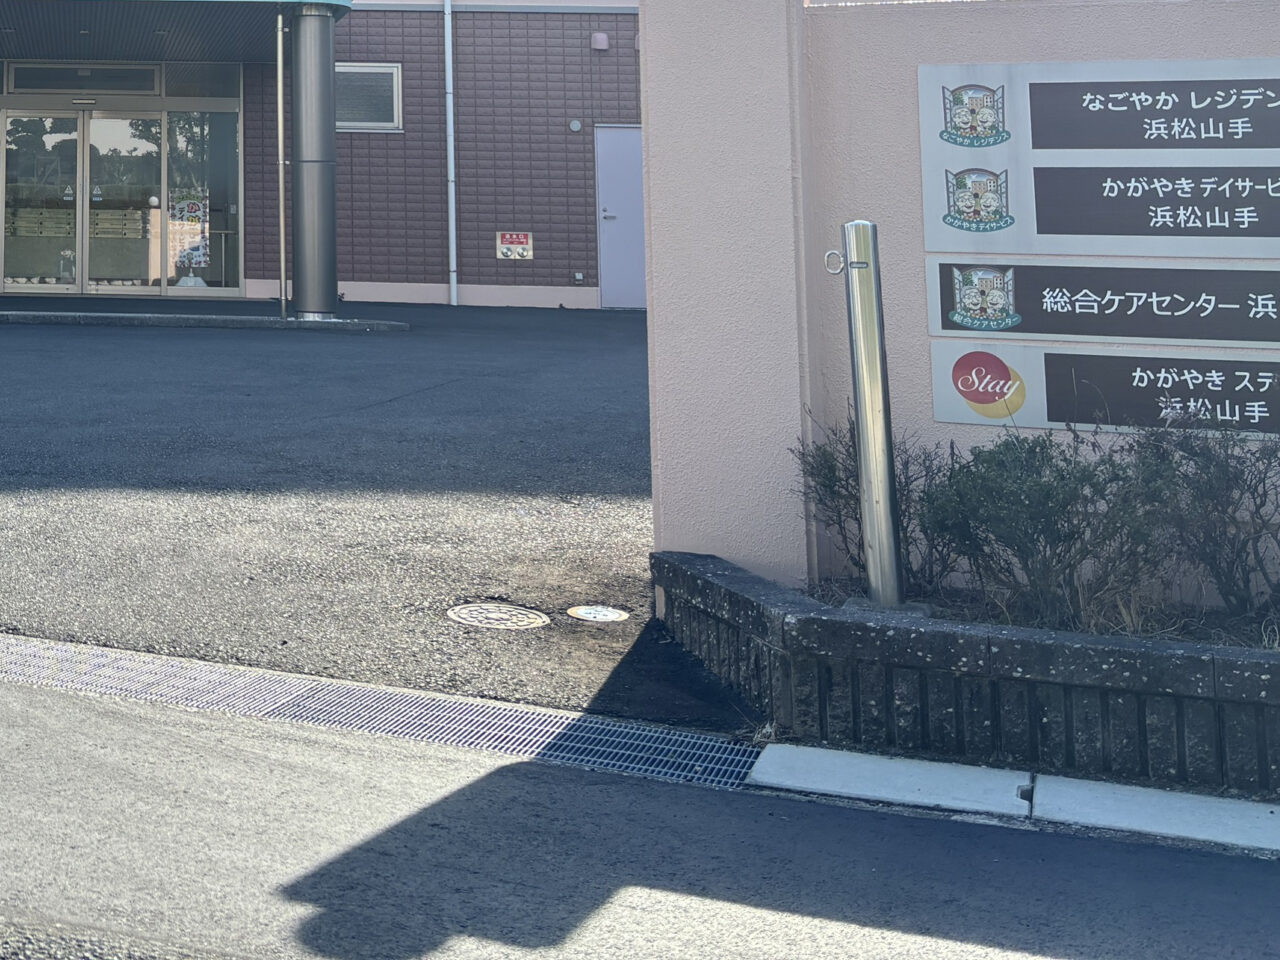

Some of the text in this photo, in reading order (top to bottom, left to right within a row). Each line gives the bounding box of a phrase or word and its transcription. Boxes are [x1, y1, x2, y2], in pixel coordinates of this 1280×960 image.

[1082, 91, 1180, 111] なごやか
[1142, 117, 1254, 140] 浜松山手
[1148, 205, 1260, 228] 浜松山手
[1042, 288, 1278, 319] 総合ケアセンター 浜
[958, 366, 1020, 401] Stay
[1132, 367, 1226, 391] かがやき
[1158, 396, 1270, 423] 浜松山手
